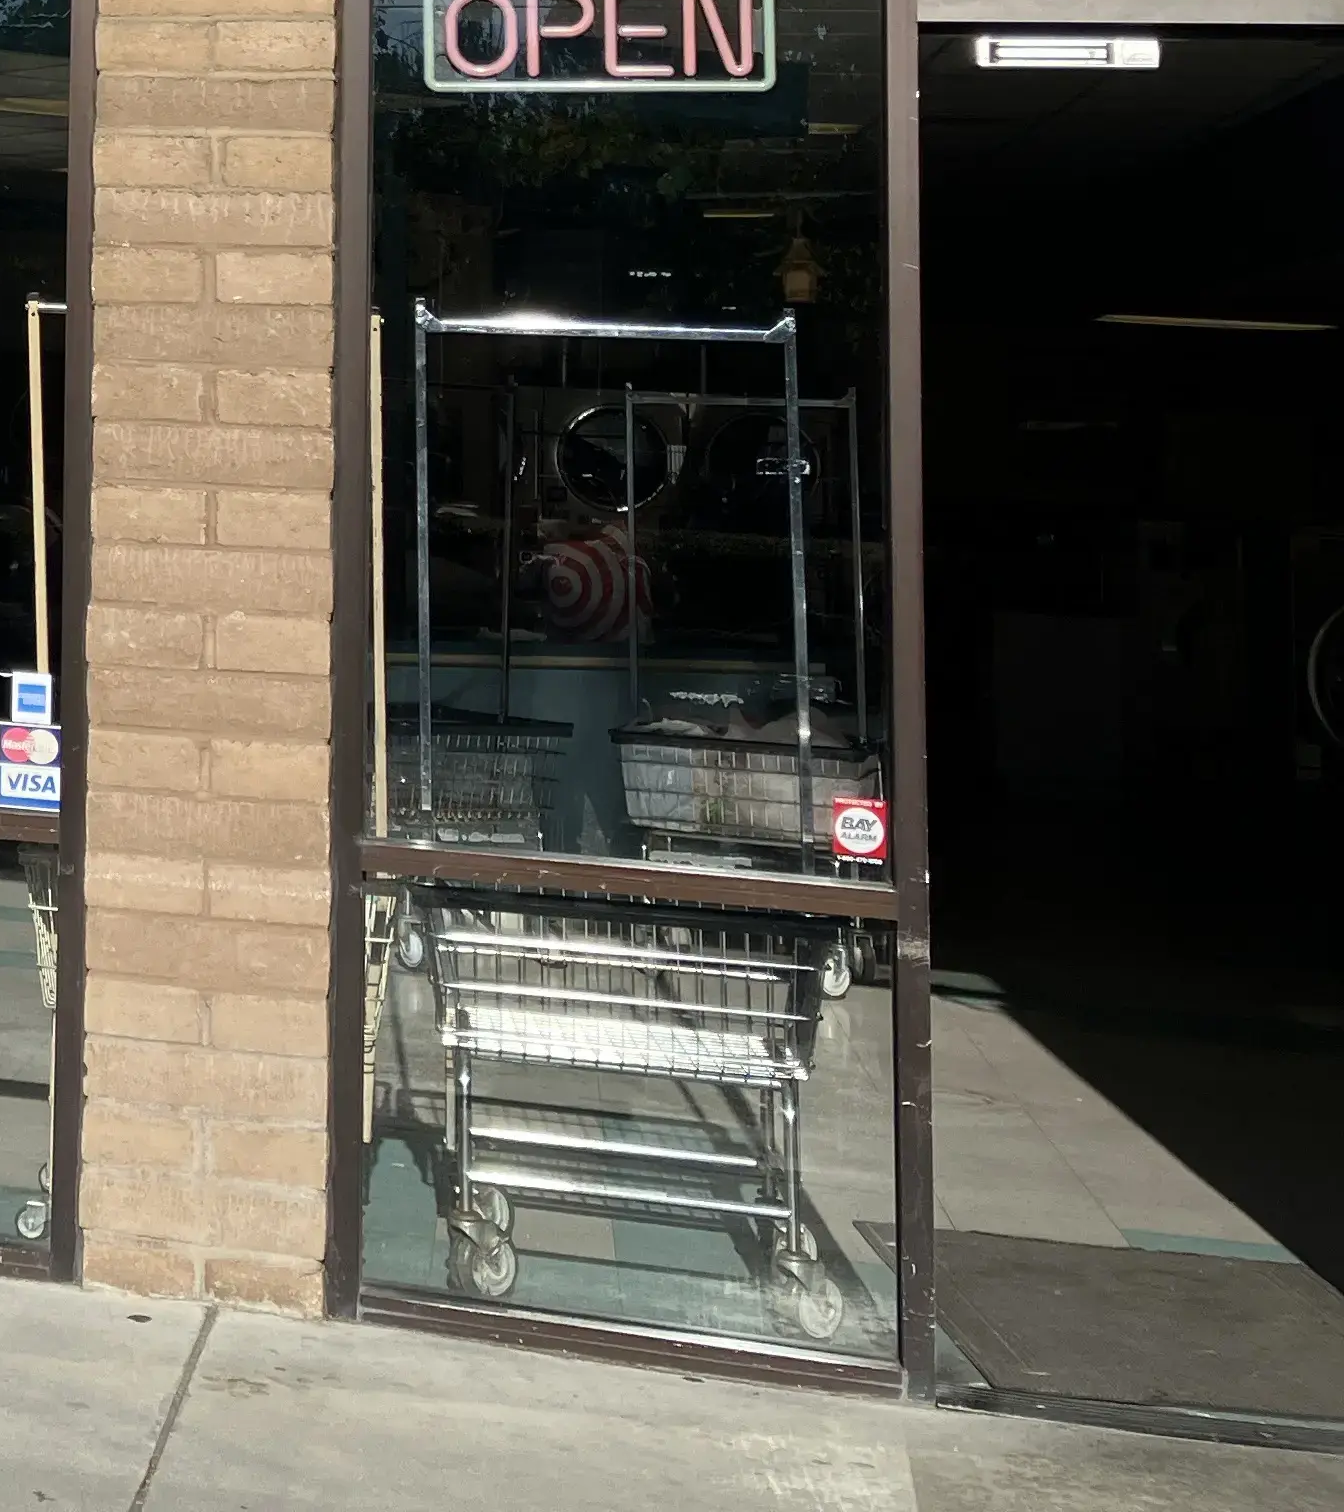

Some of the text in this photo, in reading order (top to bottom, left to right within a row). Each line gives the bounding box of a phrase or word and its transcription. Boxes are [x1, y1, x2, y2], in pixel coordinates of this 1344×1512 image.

[8, 773, 56, 794] VISA
[841, 816, 878, 832] BAY
[840, 832, 878, 842] ALARM
